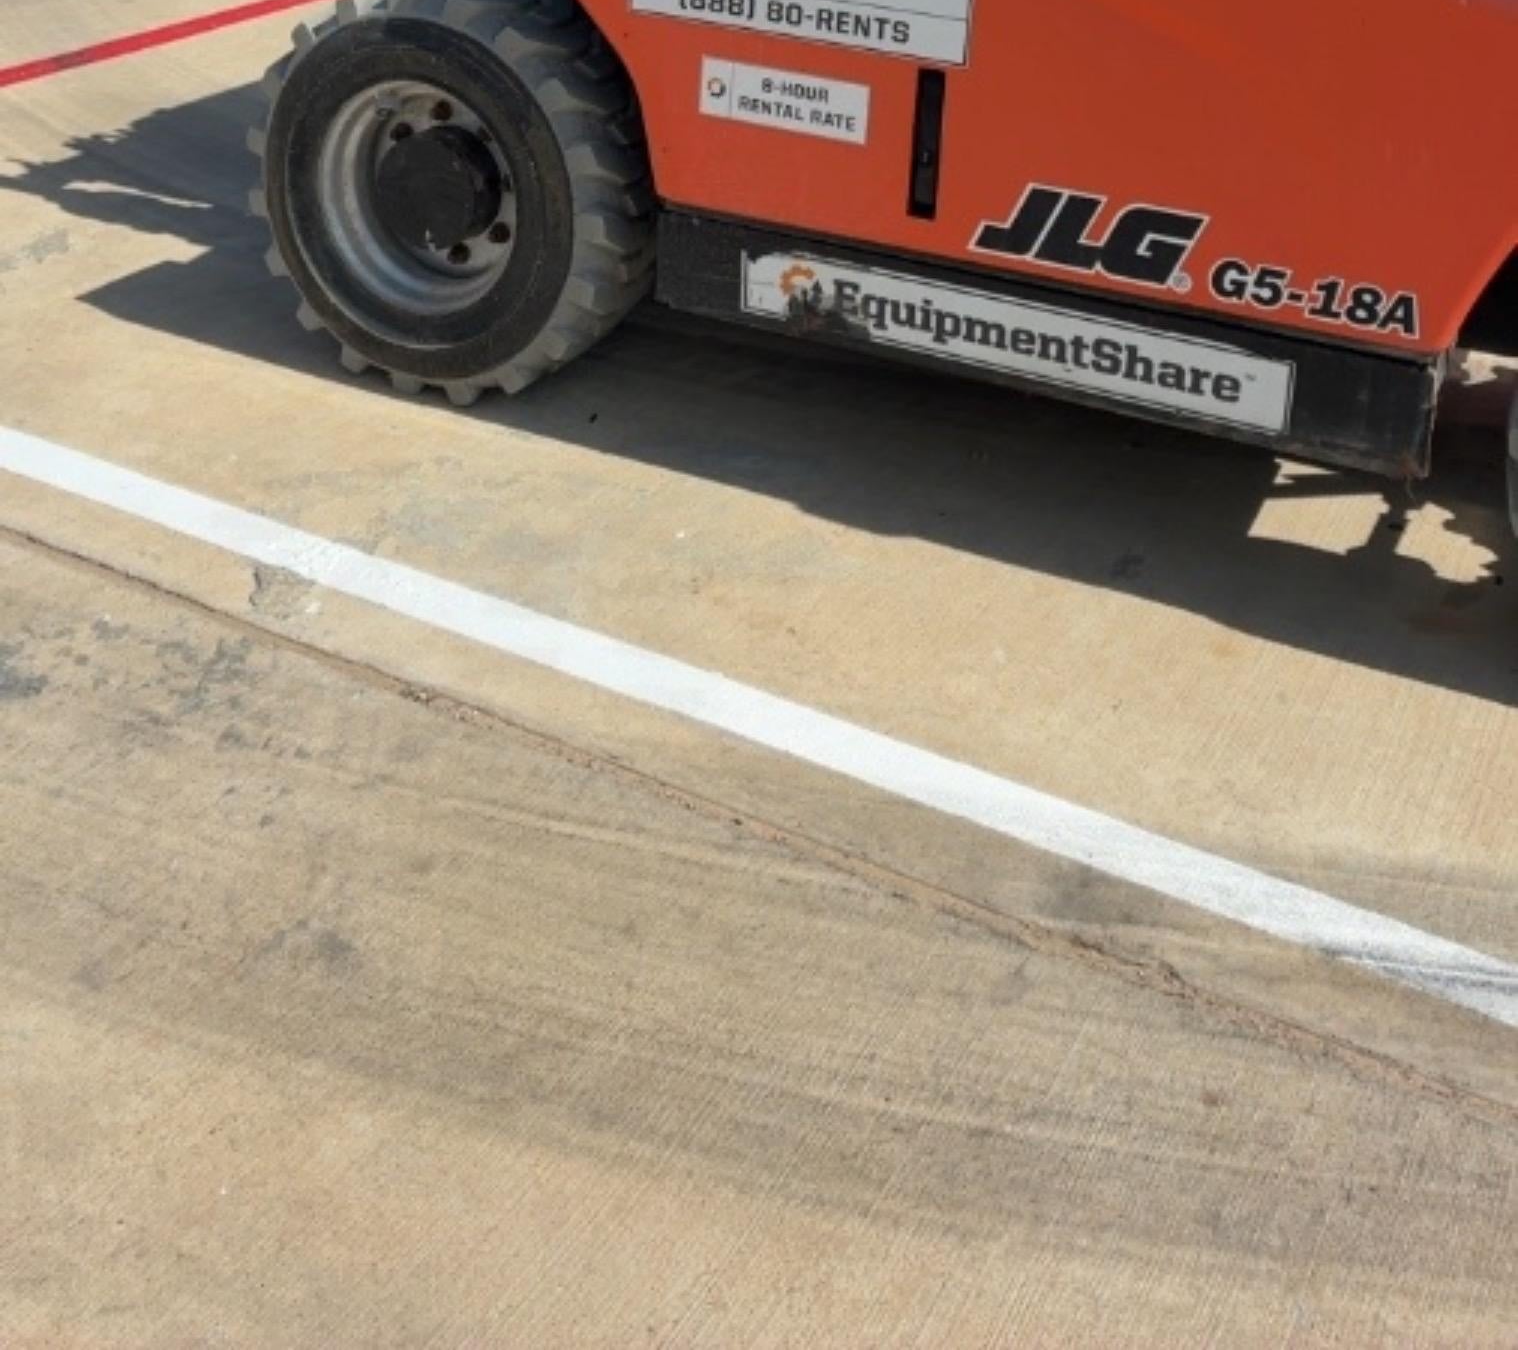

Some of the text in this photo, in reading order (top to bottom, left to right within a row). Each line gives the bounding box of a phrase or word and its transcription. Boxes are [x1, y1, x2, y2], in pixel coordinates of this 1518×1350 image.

[767, 1, 911, 44] 80-RENTS
[738, 95, 856, 132] RENTAL RATE
[761, 77, 829, 103] 8-HOUR
[970, 184, 1209, 287] JLG
[1209, 259, 1420, 340] G5-18A
[833, 278, 1242, 403] EquipmentShare
